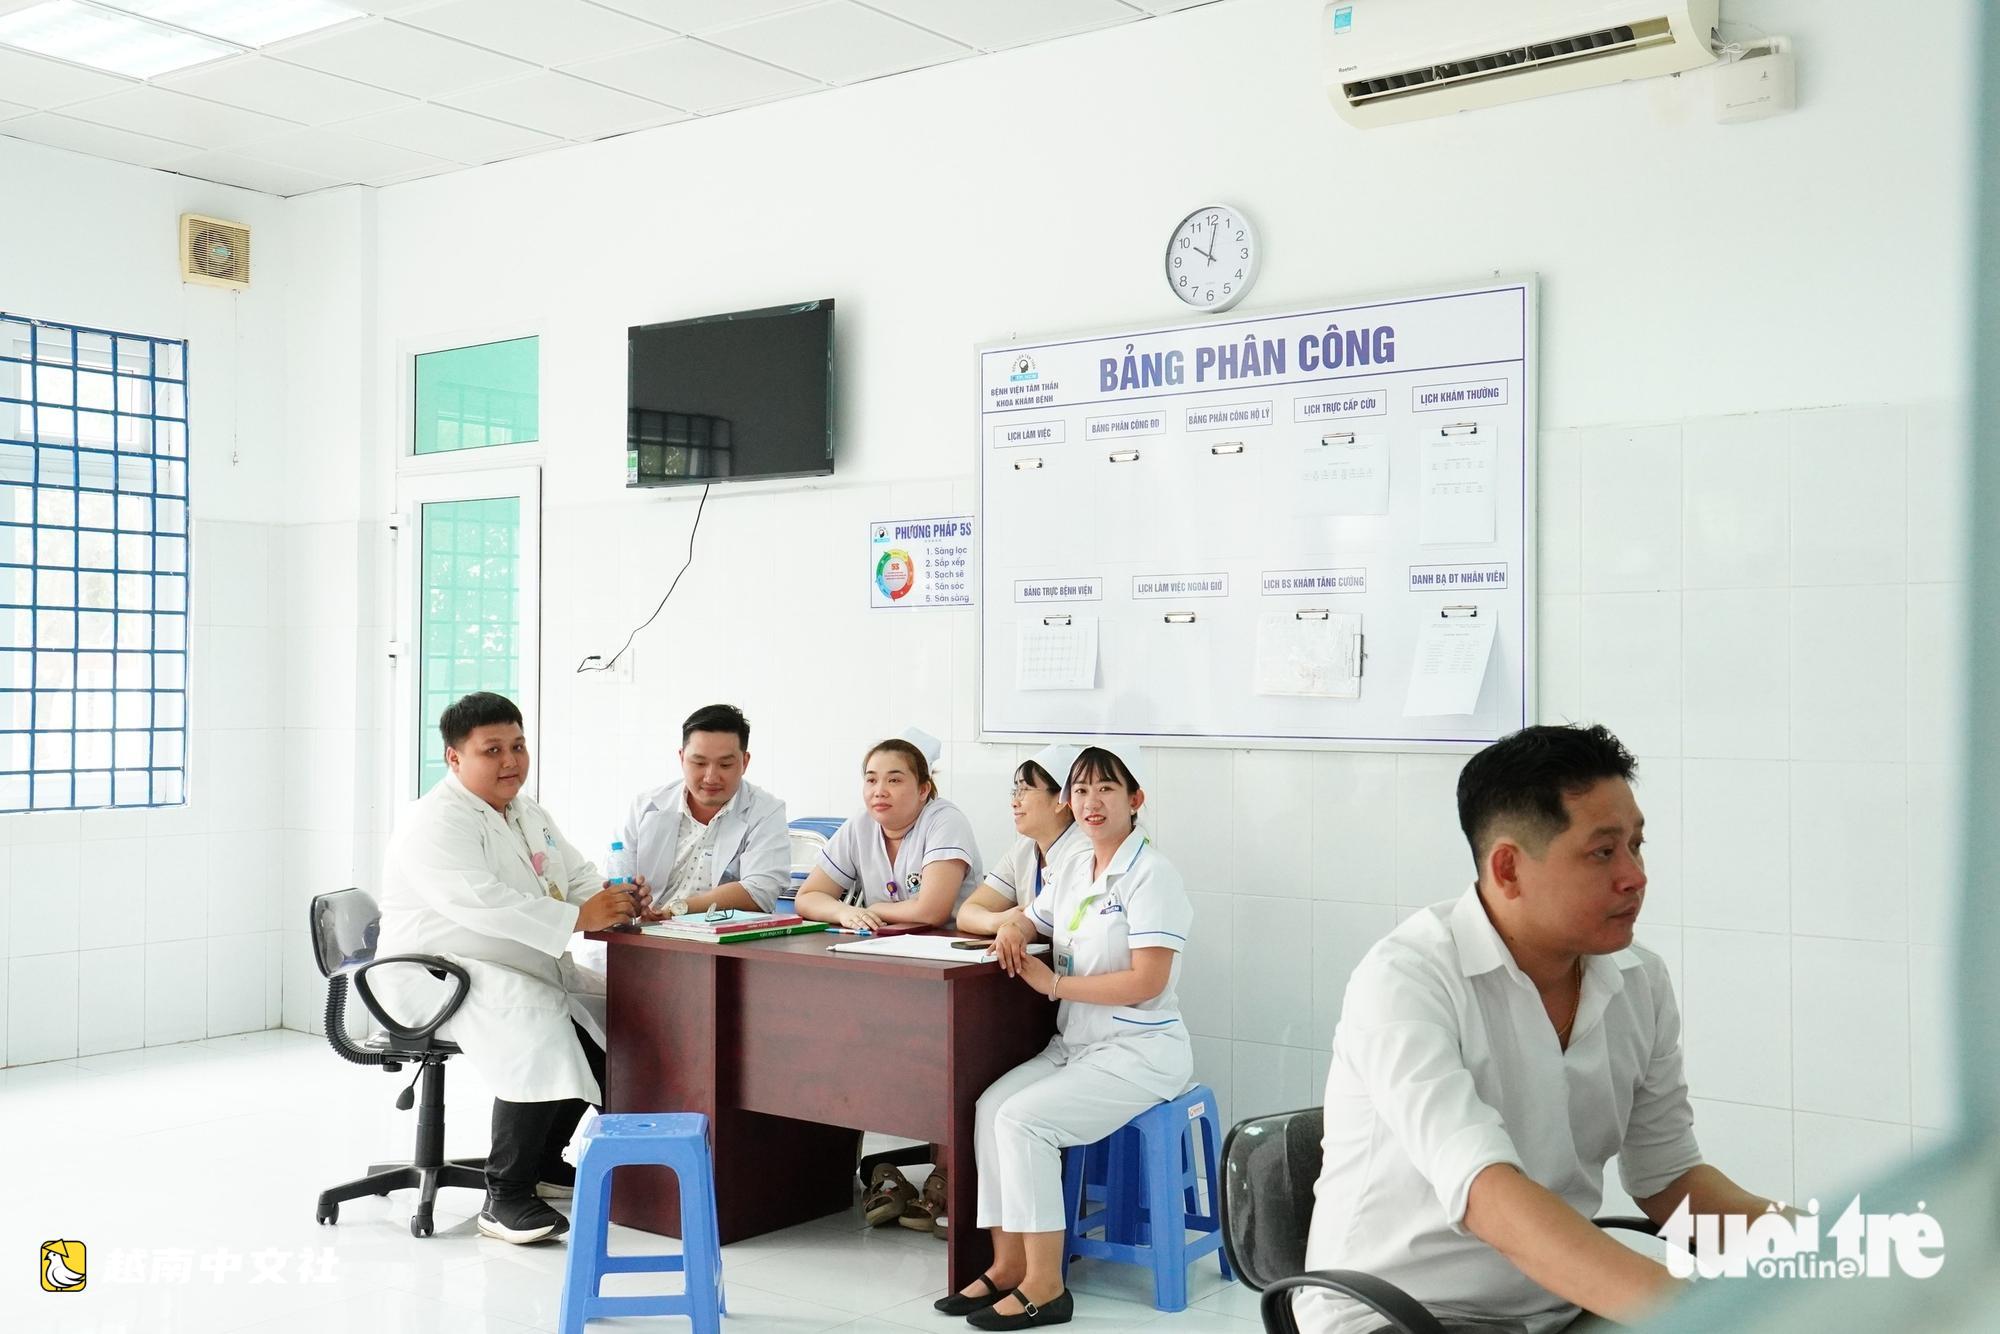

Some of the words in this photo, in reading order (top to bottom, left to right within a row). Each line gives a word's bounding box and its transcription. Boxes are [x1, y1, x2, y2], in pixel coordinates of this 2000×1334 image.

[1206, 214, 1219, 226] 12
[1226, 218, 1230, 229] 1
[1191, 222, 1202, 234] 11
[1235, 230, 1244, 241] 2
[1179, 237, 1191, 249] 10
[1240, 247, 1249, 259] 3
[1174, 256, 1183, 268] 9
[1234, 268, 1243, 280] 4
[1179, 275, 1188, 287] 8
[1191, 286, 1199, 298] 7
[1223, 282, 1232, 294] 5
[1206, 289, 1215, 301] 6
[1100, 343, 1184, 392] BẢNG
[1196, 333, 1286, 382] PHÂN
[1299, 323, 1395, 371] CÔNG
[991, 387, 1008, 397] BỆNH
[1010, 384, 1024, 395] VIỆN
[1026, 384, 1040, 392] TÂM
[1042, 381, 1059, 391] THẦN
[996, 399, 1013, 407] KHOA
[1015, 396, 1034, 405] KHÁM
[1036, 394, 1053, 404] BỆNH
[1420, 393, 1438, 406] LỊCH
[1440, 389, 1464, 402] KHÁM
[1466, 386, 1499, 400] THƯỜNG
[1304, 402, 1321, 417] LỊCH
[1322, 401, 1341, 415] TRỰC
[1343, 398, 1358, 411] CẤP
[1360, 396, 1376, 409] CỨU
[1188, 412, 1207, 425] BẢNG
[1209, 410, 1228, 423] PHÂN
[1229, 409, 1249, 421] CÔNG
[1250, 409, 1260, 421] HỘ
[1262, 407, 1270, 418] LÝ
[1092, 421, 1110, 433] BẢNG
[1111, 419, 1129, 432] PHÂN
[1131, 418, 1149, 430] CÔNG
[1007, 431, 1021, 442] LỊCH
[1023, 428, 1036, 439] LÀM
[1037, 427, 1051, 440] VIỆC
[895, 524, 931, 540] PHƯƠNG
[933, 520, 957, 537] PHÁP
[960, 521, 972, 536] 5S
[1264, 577, 1279, 591] LỊCH
[1281, 579, 1292, 589] BS
[1293, 575, 1315, 588] KHÁM
[1317, 575, 1336, 587] TĂNG
[1338, 574, 1364, 587] CƯỜNG
[1412, 574, 1433, 585] DANH
[1435, 573, 1447, 587] BẠ
[1449, 573, 1459, 583] ĐT
[1461, 570, 1484, 583] NHÂN
[1485, 569, 1505, 582] VIÊN
[1024, 585, 1041, 597] BẢNG
[1042, 585, 1058, 598] TRỰC
[1059, 584, 1077, 597] BỆNH
[1078, 584, 1093, 597] VIỆN
[1138, 583, 1153, 596] LỊCH
[1154, 581, 1169, 593] LÀM
[1170, 580, 1185, 593] VIỆC
[1187, 579, 1208, 591] NGOÀI
[1210, 578, 1222, 591] GIỜ
